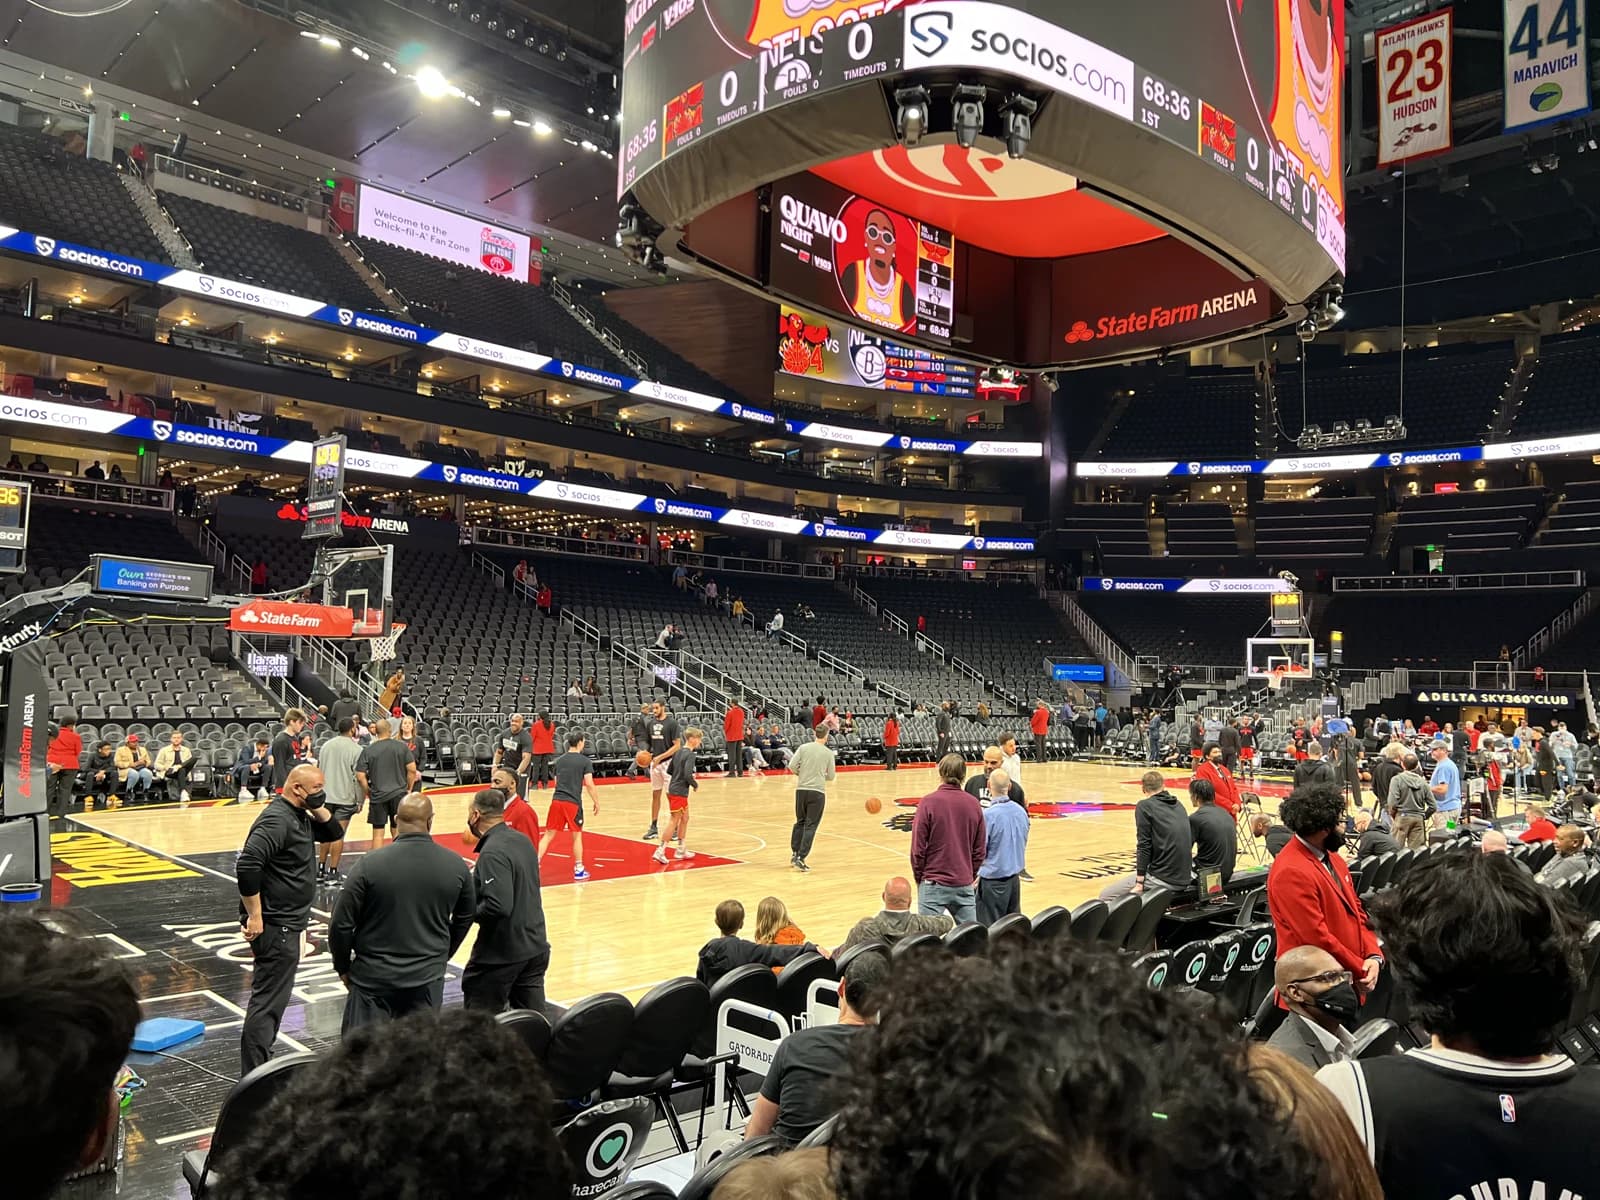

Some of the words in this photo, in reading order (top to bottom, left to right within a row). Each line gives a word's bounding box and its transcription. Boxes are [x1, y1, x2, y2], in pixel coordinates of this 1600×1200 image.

[848, 22, 873, 61] 0
[1382, 30, 1416, 47] ATLANTA
[1417, 19, 1445, 36] HAWKS
[1509, 0, 1582, 60] 44
[843, 61, 887, 81] TIMEOUTS
[1386, 38, 1443, 104] 23
[1513, 53, 1578, 84] MARAVICH
[720, 70, 738, 107] 0
[783, 85, 808, 99] FOULS
[1142, 76, 1190, 120] 68:36
[1141, 108, 1160, 129] 1ST
[1393, 96, 1437, 121] HUDSON
[627, 119, 657, 162] 68:36
[1247, 137, 1259, 170] 0
[375, 208, 418, 228] Welcome
[420, 222, 430, 231] to
[432, 225, 448, 236] the
[780, 194, 847, 243] QUAVO
[430, 236, 446, 247] Fan
[448, 240, 470, 253] Zone
[780, 220, 814, 246] NIGHT
[1200, 288, 1257, 318] ARENA
[372, 518, 409, 533] ARENA
[117, 579, 147, 589] Banking
[160, 583, 190, 592] Purpose
[119, 568, 144, 579] Own
[24, 693, 35, 727] ARENA
[1432, 692, 1477, 703] DELTA
[1535, 695, 1569, 705] CLUB
[729, 1041, 773, 1065] GATORADE
